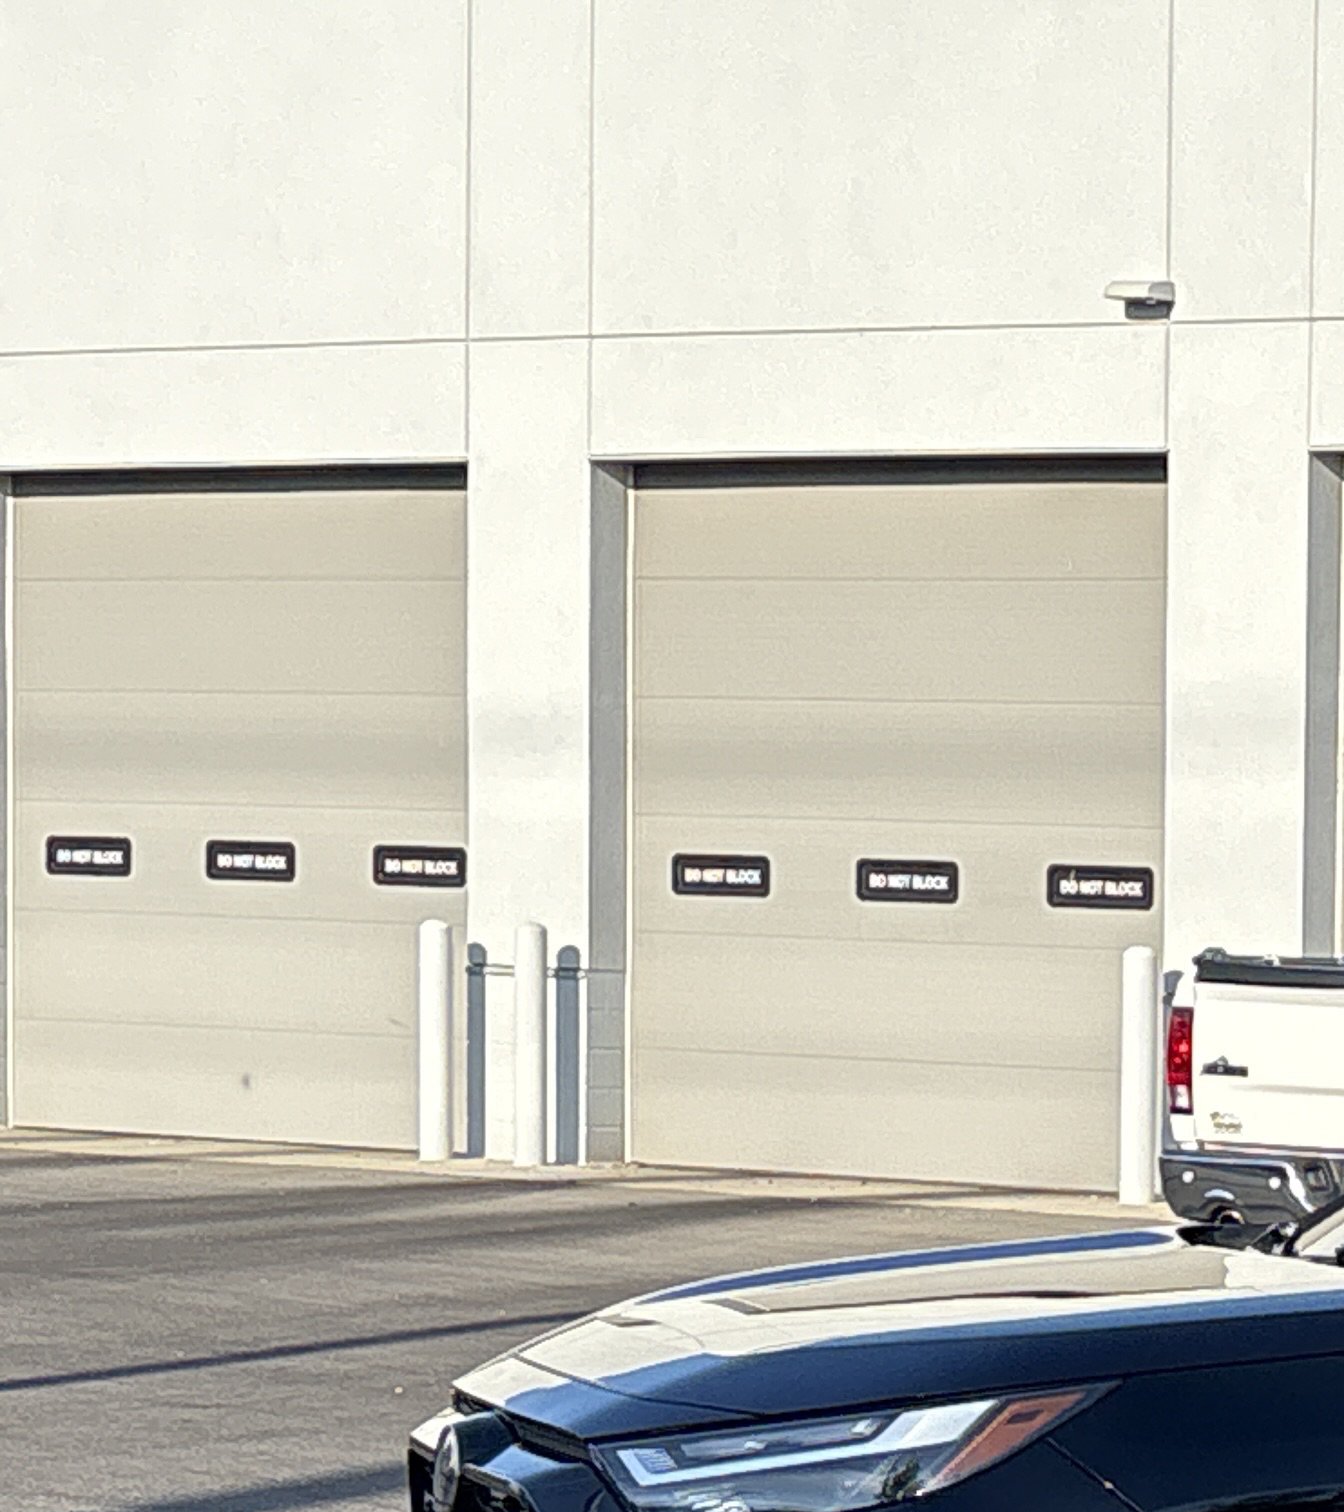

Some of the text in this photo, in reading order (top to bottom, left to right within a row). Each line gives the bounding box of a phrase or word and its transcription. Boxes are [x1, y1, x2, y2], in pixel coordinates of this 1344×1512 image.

[93, 850, 123, 865] BLOCK
[255, 854, 287, 870] BLOCK
[424, 859, 458, 876] BLOCK
[684, 867, 701, 882] DO
[726, 868, 762, 885] BLOCK
[869, 872, 949, 890] DO NOT BLOCK
[1059, 879, 1143, 897] DO NOT BLOCK
